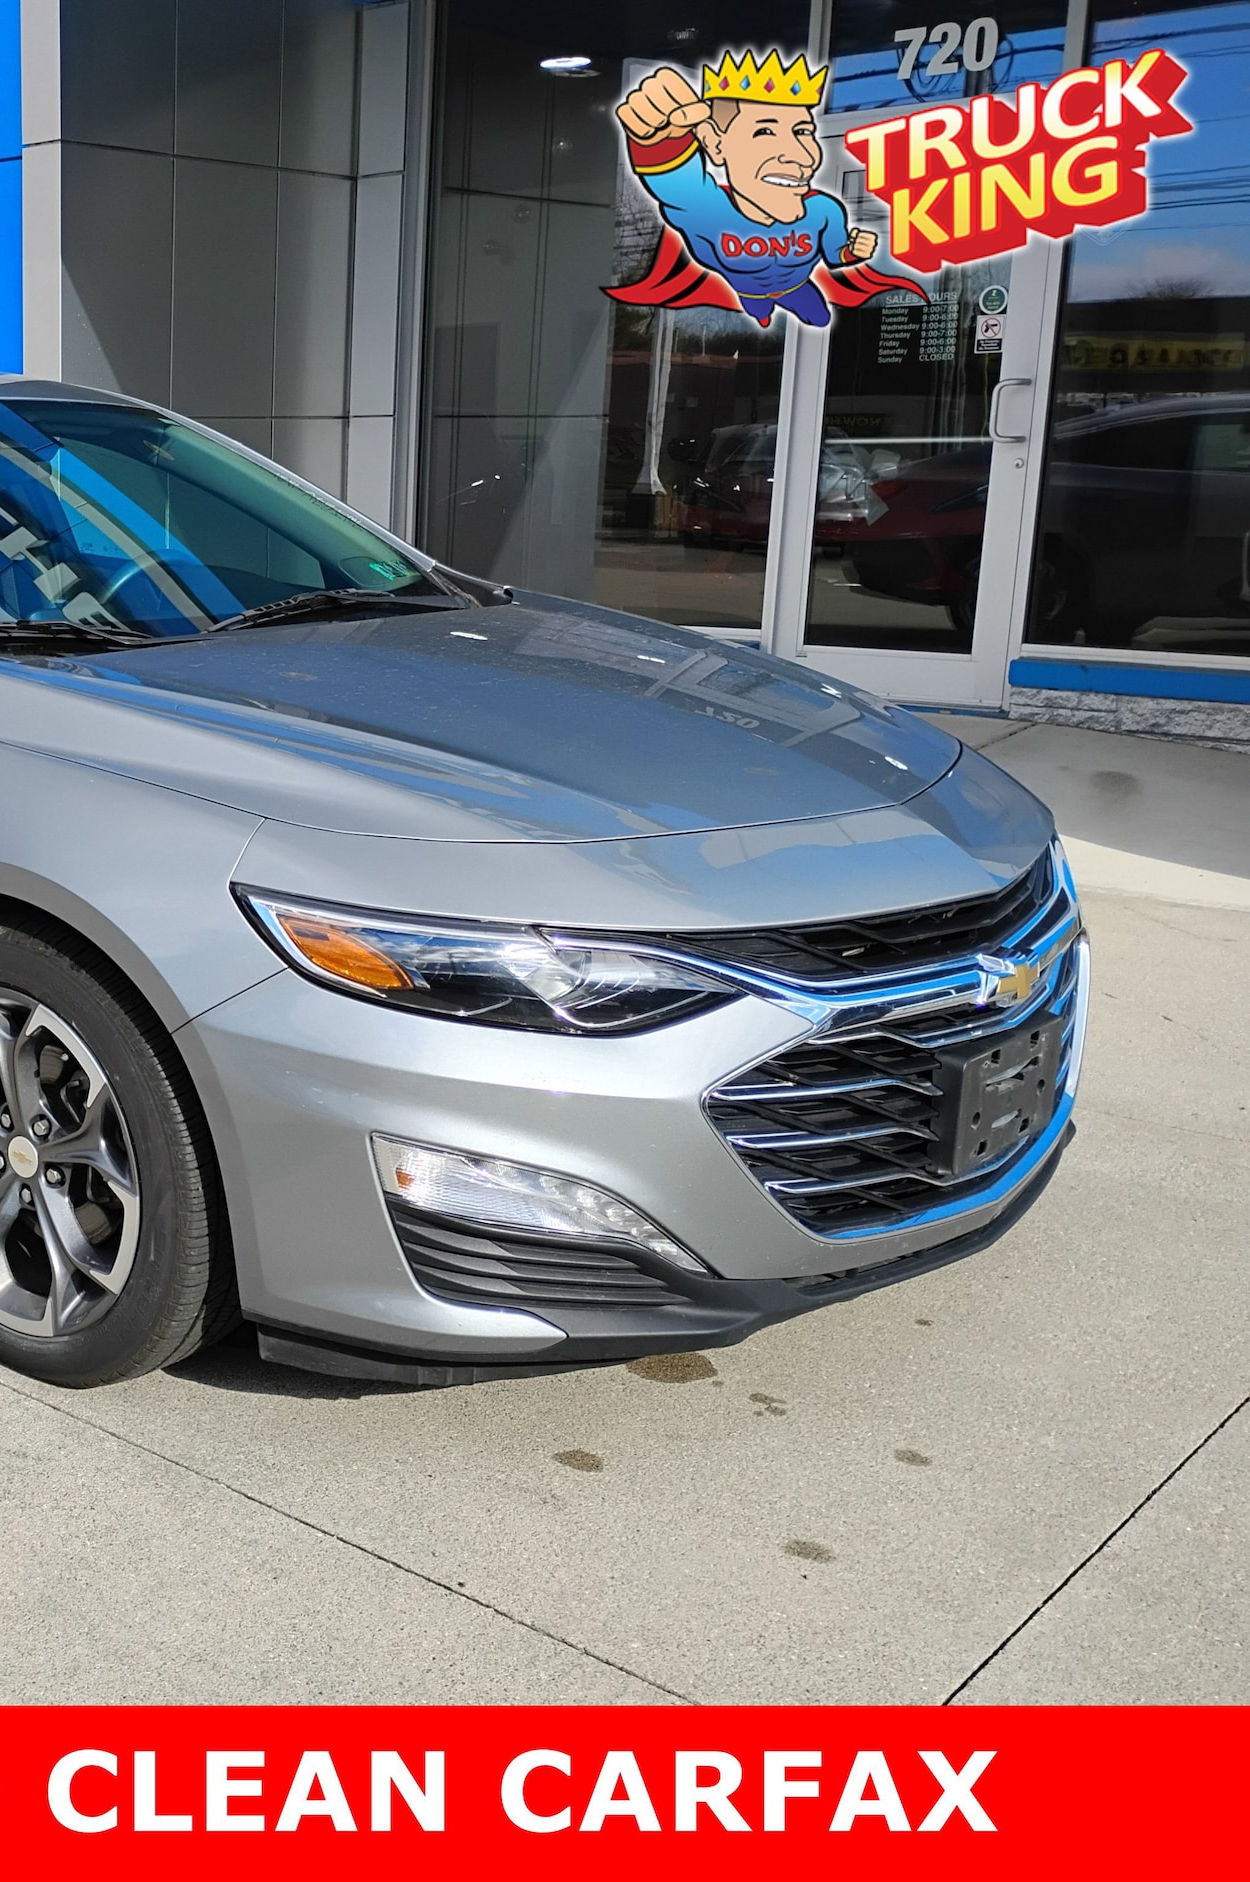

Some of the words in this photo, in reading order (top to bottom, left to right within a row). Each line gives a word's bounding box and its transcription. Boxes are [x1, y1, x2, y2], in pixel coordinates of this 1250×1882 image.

[894, 17, 999, 80] 720
[885, 294, 919, 305] SALES
[922, 291, 958, 302] OURS
[881, 307, 909, 316] Monday
[881, 315, 908, 324] Tuesday
[880, 323, 920, 331] Wednesday
[880, 331, 911, 339] Thursday
[878, 340, 900, 349] Friday
[878, 348, 908, 356] Saturday
[877, 356, 903, 364] Sunday
[919, 353, 954, 362] CLOSED
